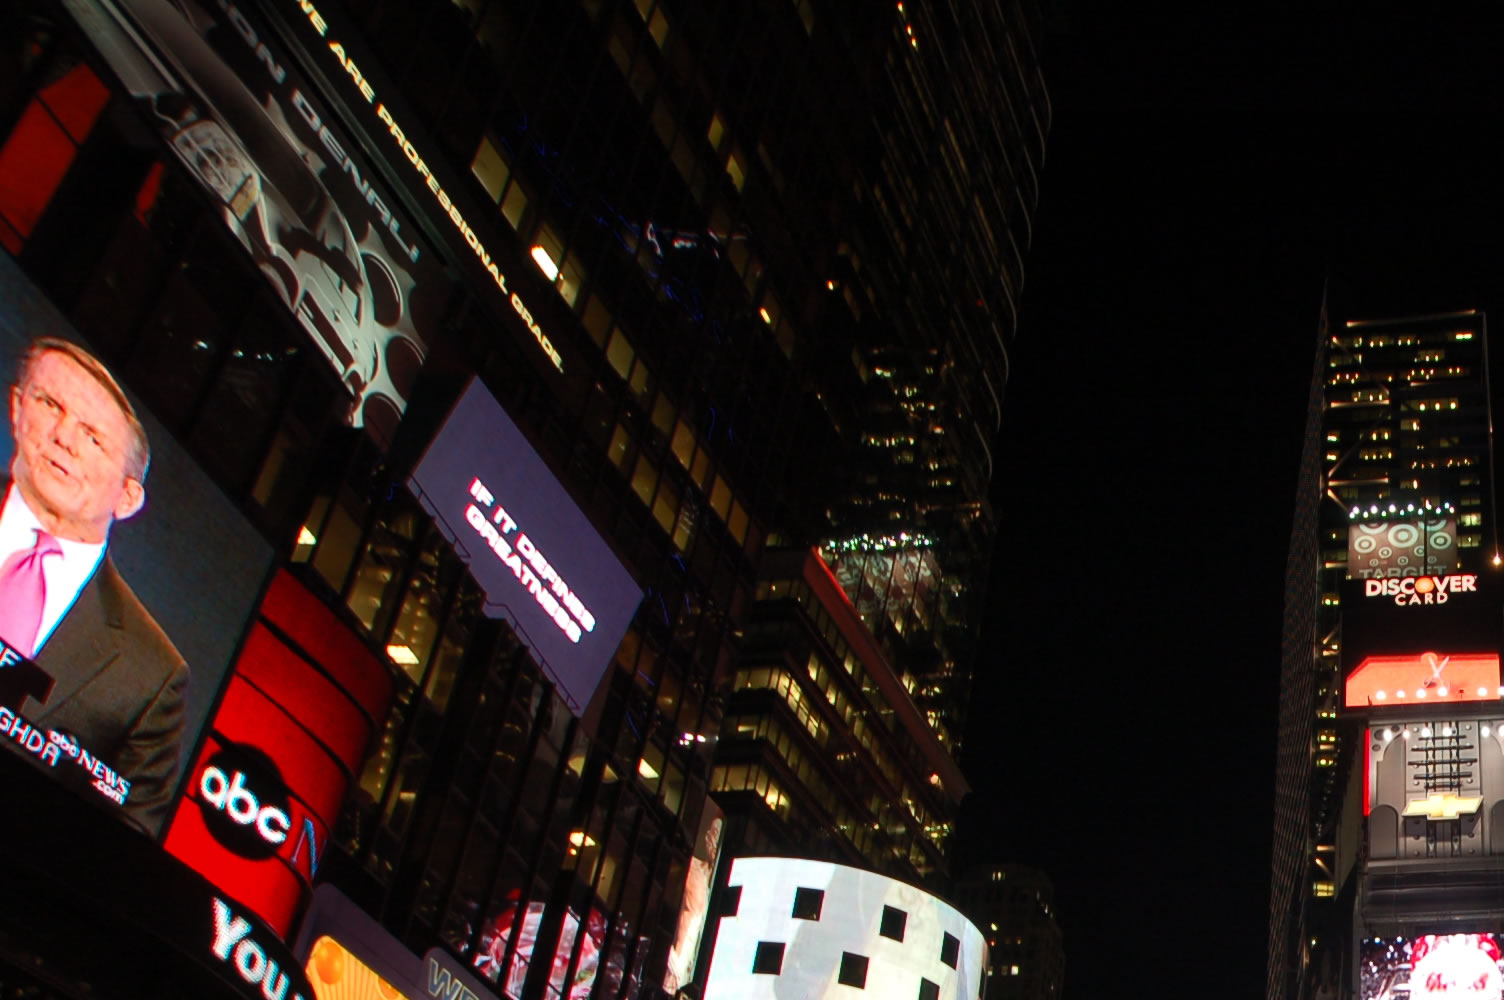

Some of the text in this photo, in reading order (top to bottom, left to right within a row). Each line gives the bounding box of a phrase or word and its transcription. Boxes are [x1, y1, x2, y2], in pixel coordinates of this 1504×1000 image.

[291, 88, 421, 263] DENALI
[328, 41, 375, 103] ARE
[376, 104, 508, 296] PROFESSIONAL
[465, 503, 582, 643] GREATNESS
[468, 477, 595, 632] IF IT DEFINES
[1365, 575, 1477, 597] DISCOVER
[1395, 593, 1448, 606] CARD
[77, 749, 131, 797] NEWS
[200, 766, 290, 843] abc
